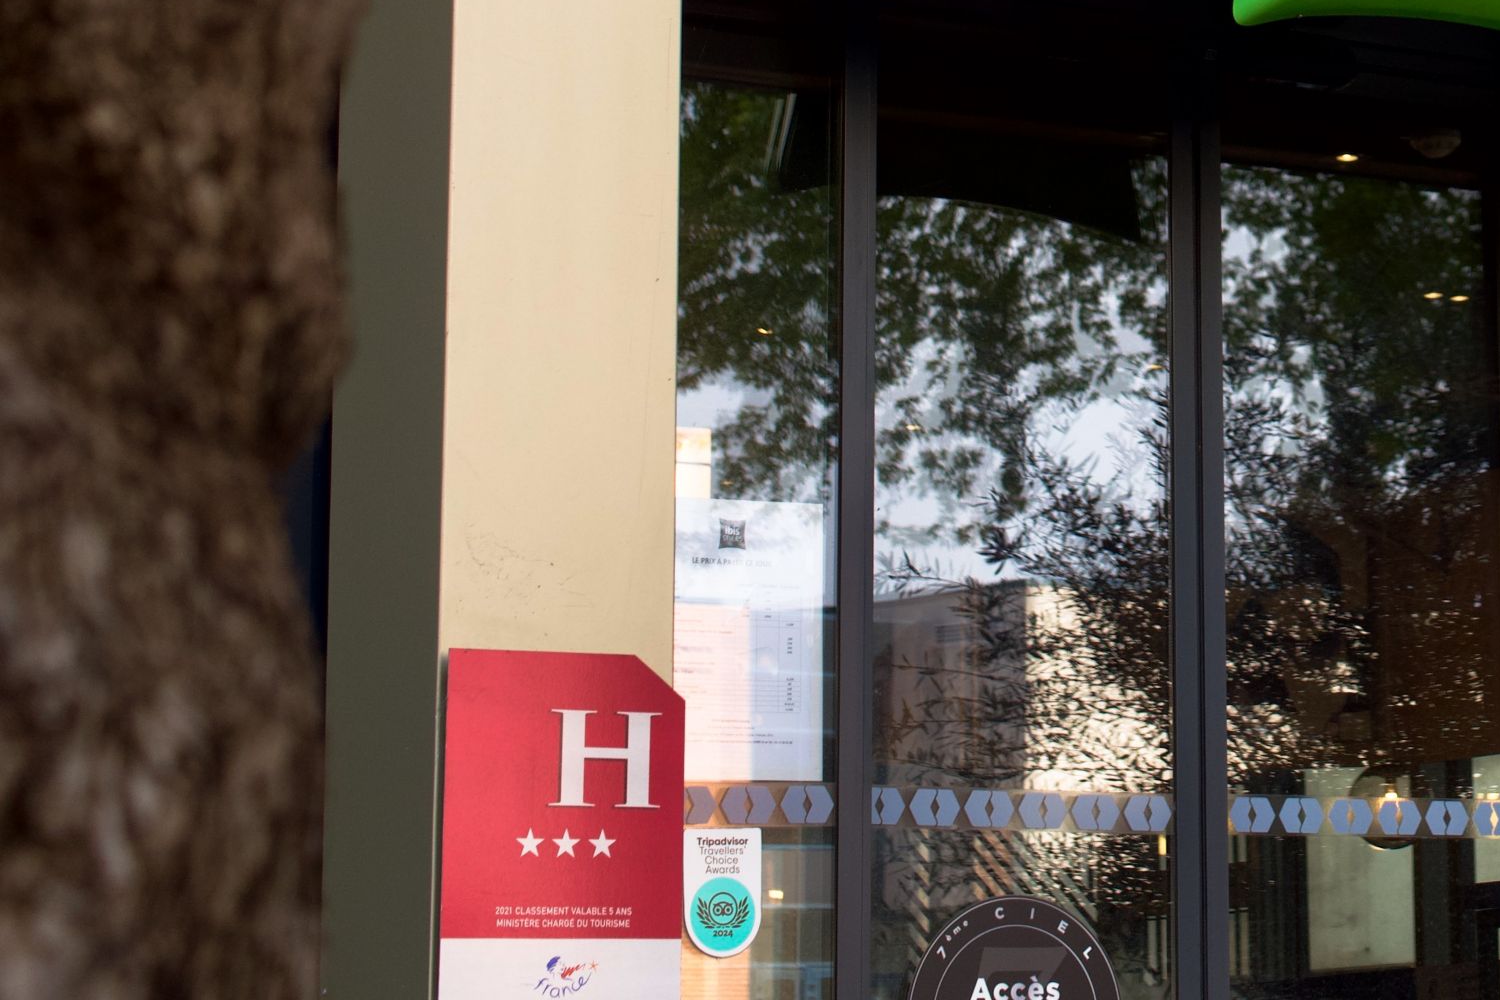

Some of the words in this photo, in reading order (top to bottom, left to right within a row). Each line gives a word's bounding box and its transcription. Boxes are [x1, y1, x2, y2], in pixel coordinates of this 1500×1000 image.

[547, 708, 664, 809] H
[696, 836, 749, 848] Tripadvisor
[704, 855, 739, 865] Choice
[705, 865, 741, 874] Awards
[515, 906, 569, 916] CLASSEMENT
[571, 906, 607, 916] VALABLE
[615, 906, 633, 916] ANS
[542, 918, 575, 928] CHARGÉ
[577, 918, 588, 928] DU
[590, 918, 631, 928] TOURISME
[969, 974, 1061, 1000] Accès
